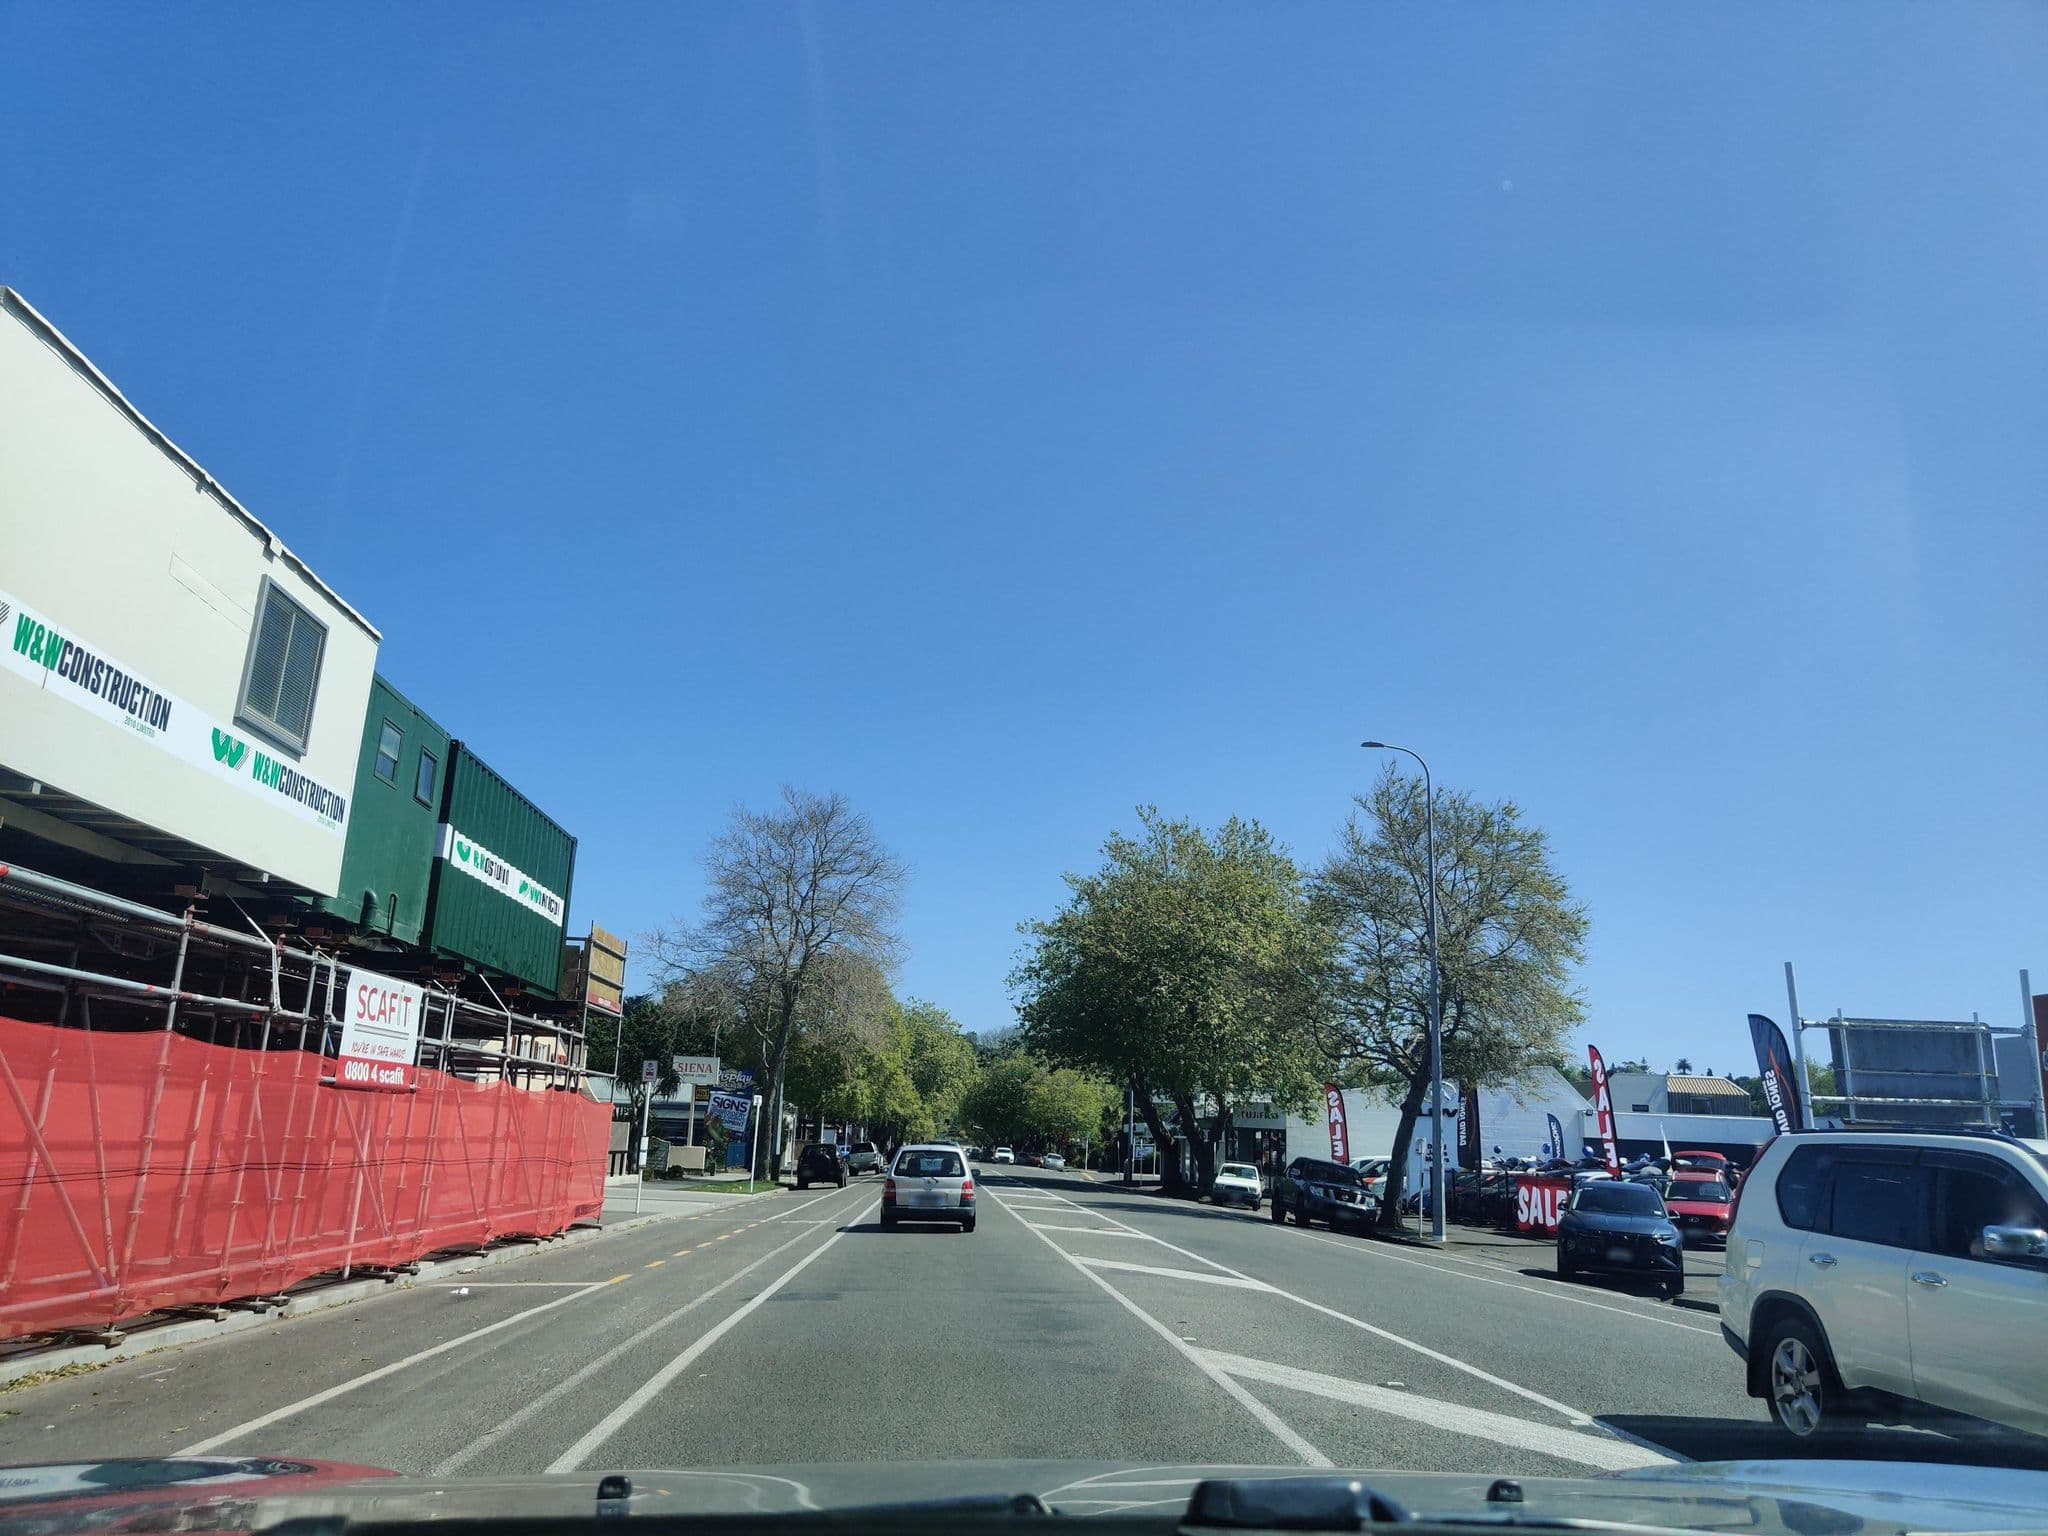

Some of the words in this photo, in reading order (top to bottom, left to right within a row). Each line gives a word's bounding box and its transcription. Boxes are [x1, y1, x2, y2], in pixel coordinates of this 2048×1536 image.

[345, 1061, 369, 1081] 0800
[371, 1064, 378, 1082] 4
[379, 1066, 404, 1085] scafit
[677, 1062, 713, 1073] SIENA
[712, 1096, 749, 1113] SIGNS
